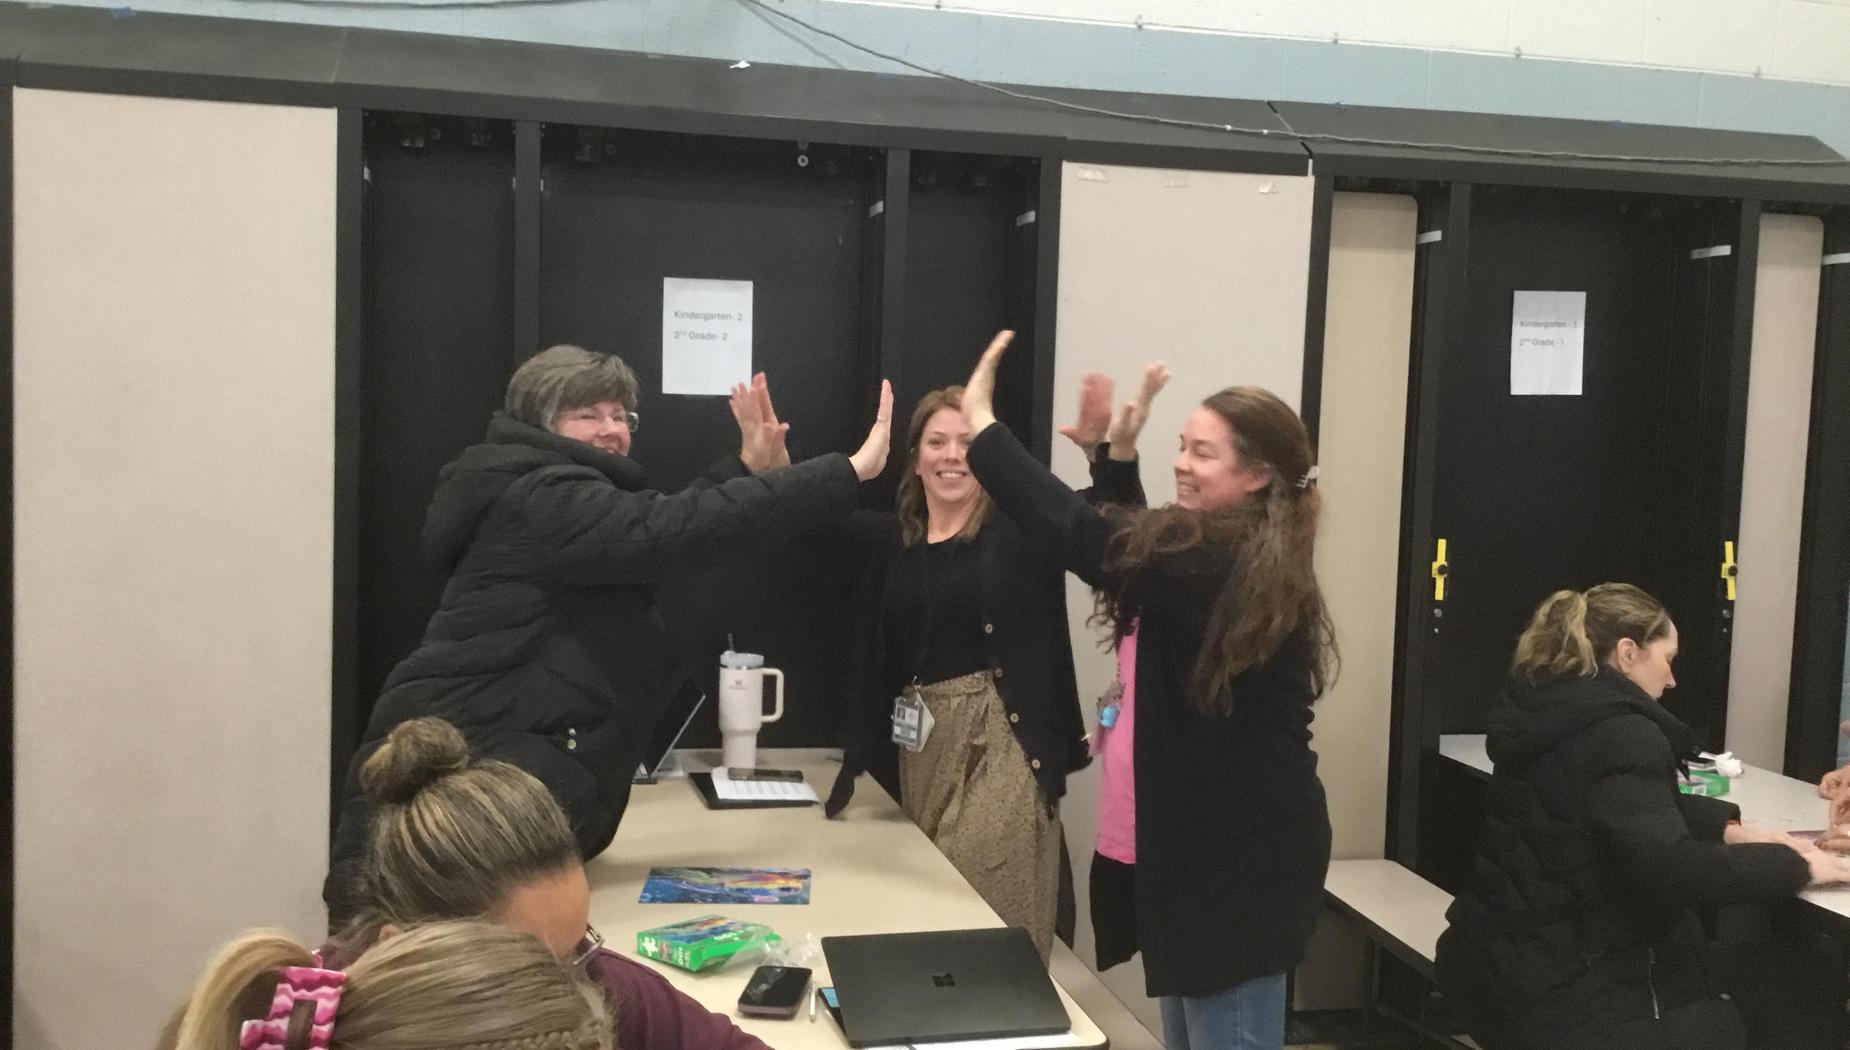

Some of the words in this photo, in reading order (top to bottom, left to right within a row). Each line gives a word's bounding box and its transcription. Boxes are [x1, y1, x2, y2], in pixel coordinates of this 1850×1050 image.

[737, 312, 744, 321] 2
[1520, 320, 1568, 330] Kindergarten
[721, 332, 728, 341] 2
